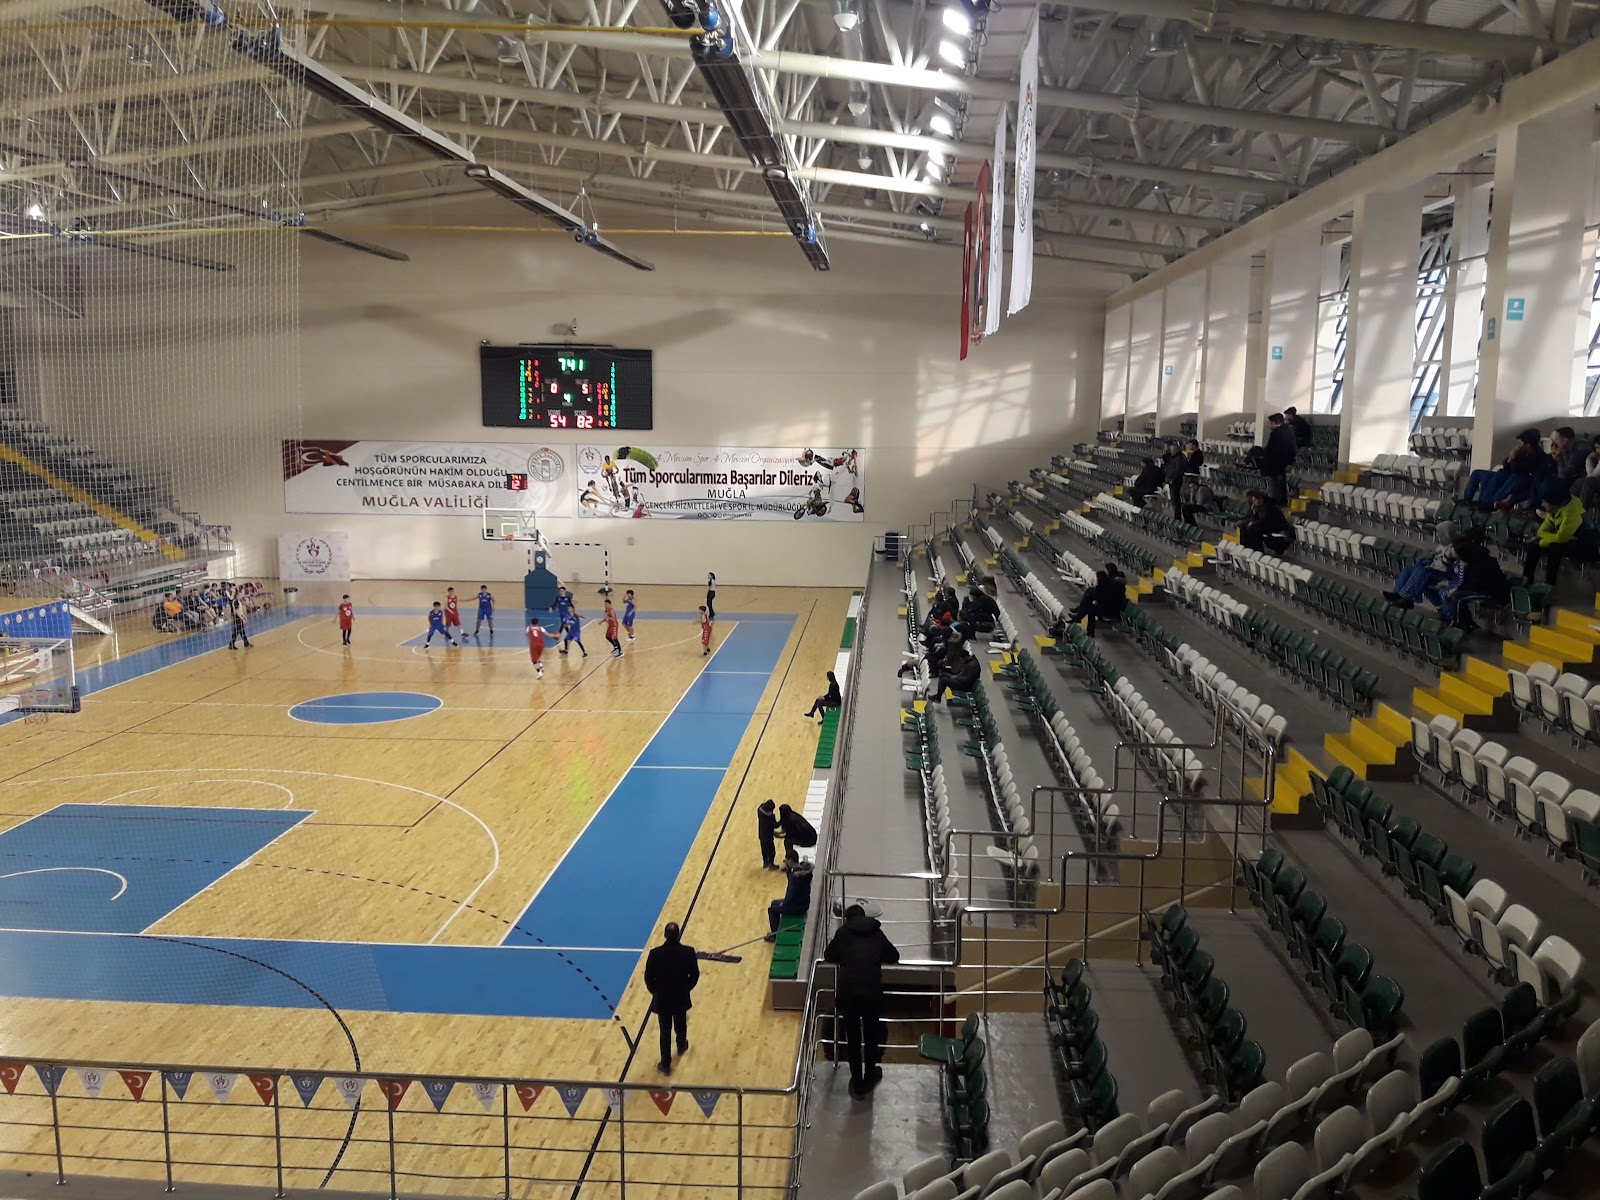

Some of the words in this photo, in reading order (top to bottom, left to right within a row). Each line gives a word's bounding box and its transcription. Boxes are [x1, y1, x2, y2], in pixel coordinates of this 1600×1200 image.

[581, 383, 589, 394] 5
[550, 414, 567, 428] 54
[576, 415, 594, 429] 82
[374, 453, 397, 463] TÜM
[400, 455, 487, 465] SPORCULARIMIZA
[354, 465, 427, 476] HOŞGÖRÜNÜN
[429, 466, 463, 477] HAKİM
[466, 467, 508, 477] OLDUĞU
[336, 477, 404, 487] CENTİLMENCE
[407, 478, 423, 488] BİR
[428, 478, 485, 489] MÜSABAKA
[488, 479, 507, 489] DİLE
[623, 467, 647, 483] Tüm
[649, 467, 728, 488] Sporcularımıza
[730, 469, 776, 490] Başarılar
[779, 469, 814, 486] Dileriz
[707, 487, 746, 499] MUĞLA
[362, 494, 419, 507] MUĞLA
[423, 495, 489, 508] VALİLİĞİ
